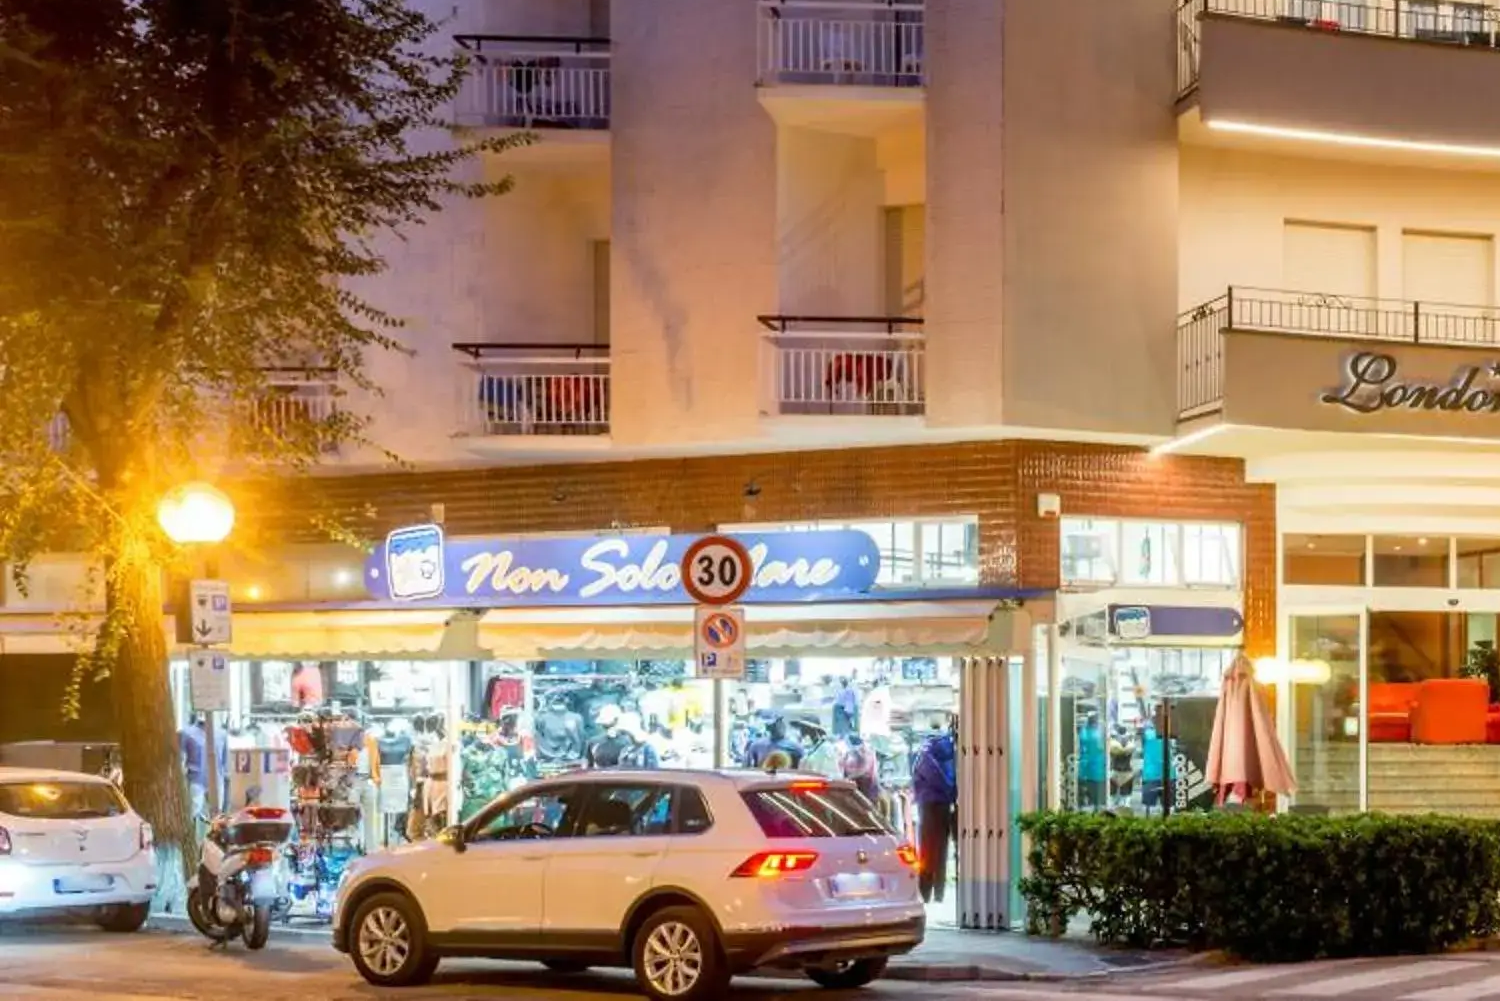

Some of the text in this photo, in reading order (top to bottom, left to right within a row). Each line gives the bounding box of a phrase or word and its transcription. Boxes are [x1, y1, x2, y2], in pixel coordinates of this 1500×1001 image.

[461, 539, 841, 598] Non Solo are
[698, 555, 737, 586] 30
